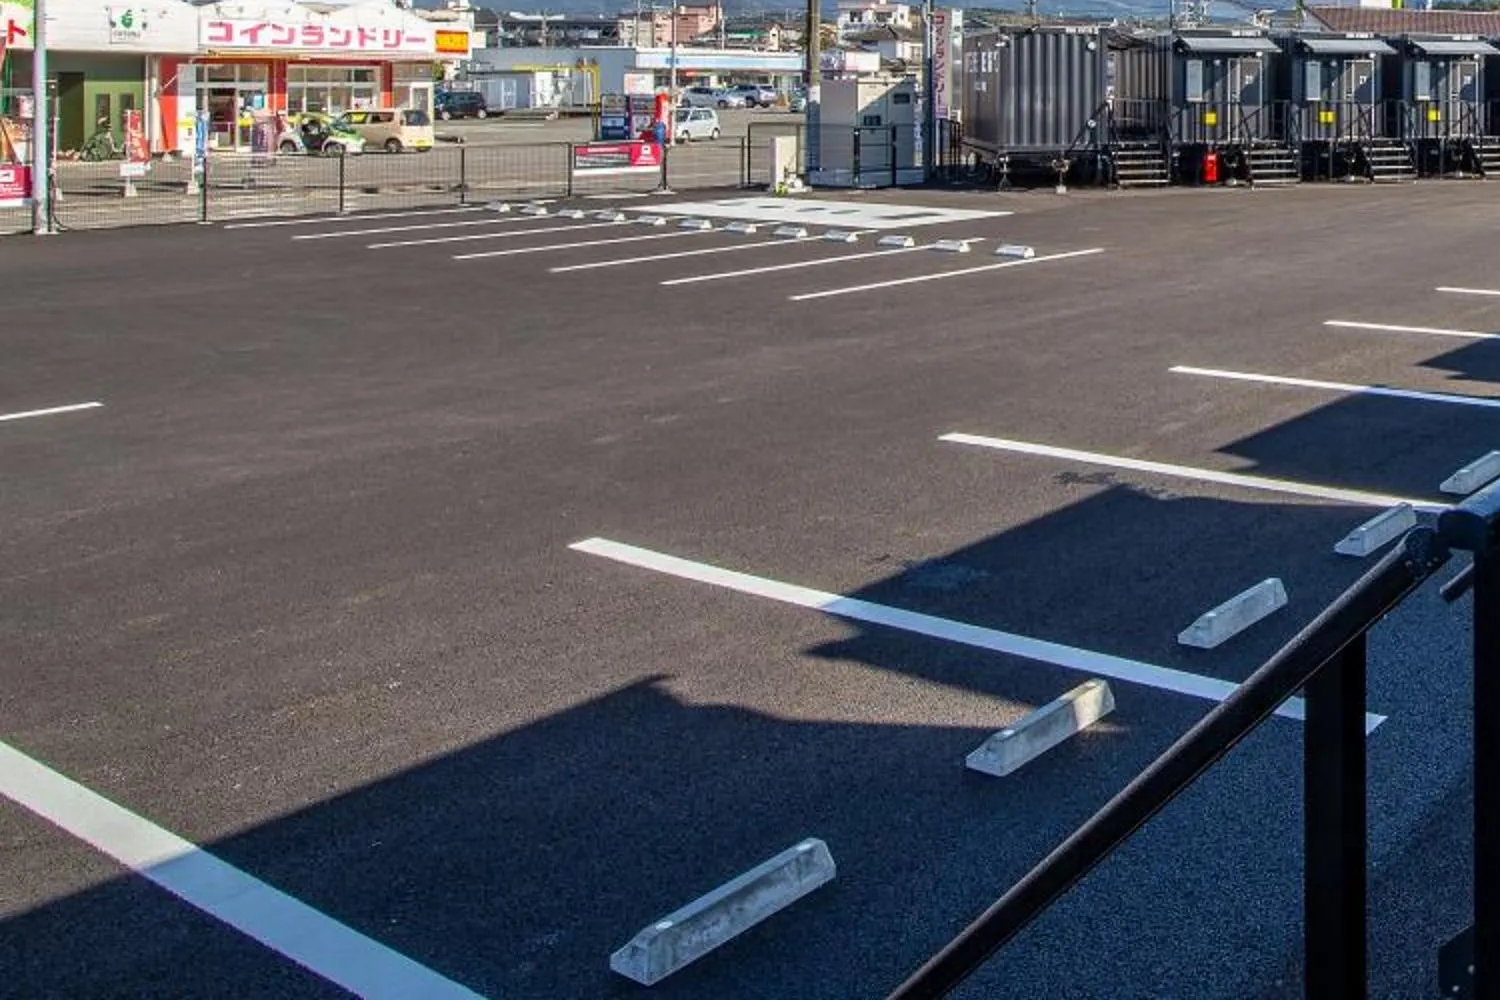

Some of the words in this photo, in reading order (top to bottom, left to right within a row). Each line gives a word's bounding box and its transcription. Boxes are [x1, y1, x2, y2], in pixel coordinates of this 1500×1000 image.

[208, 21, 426, 48] コインランドリー
